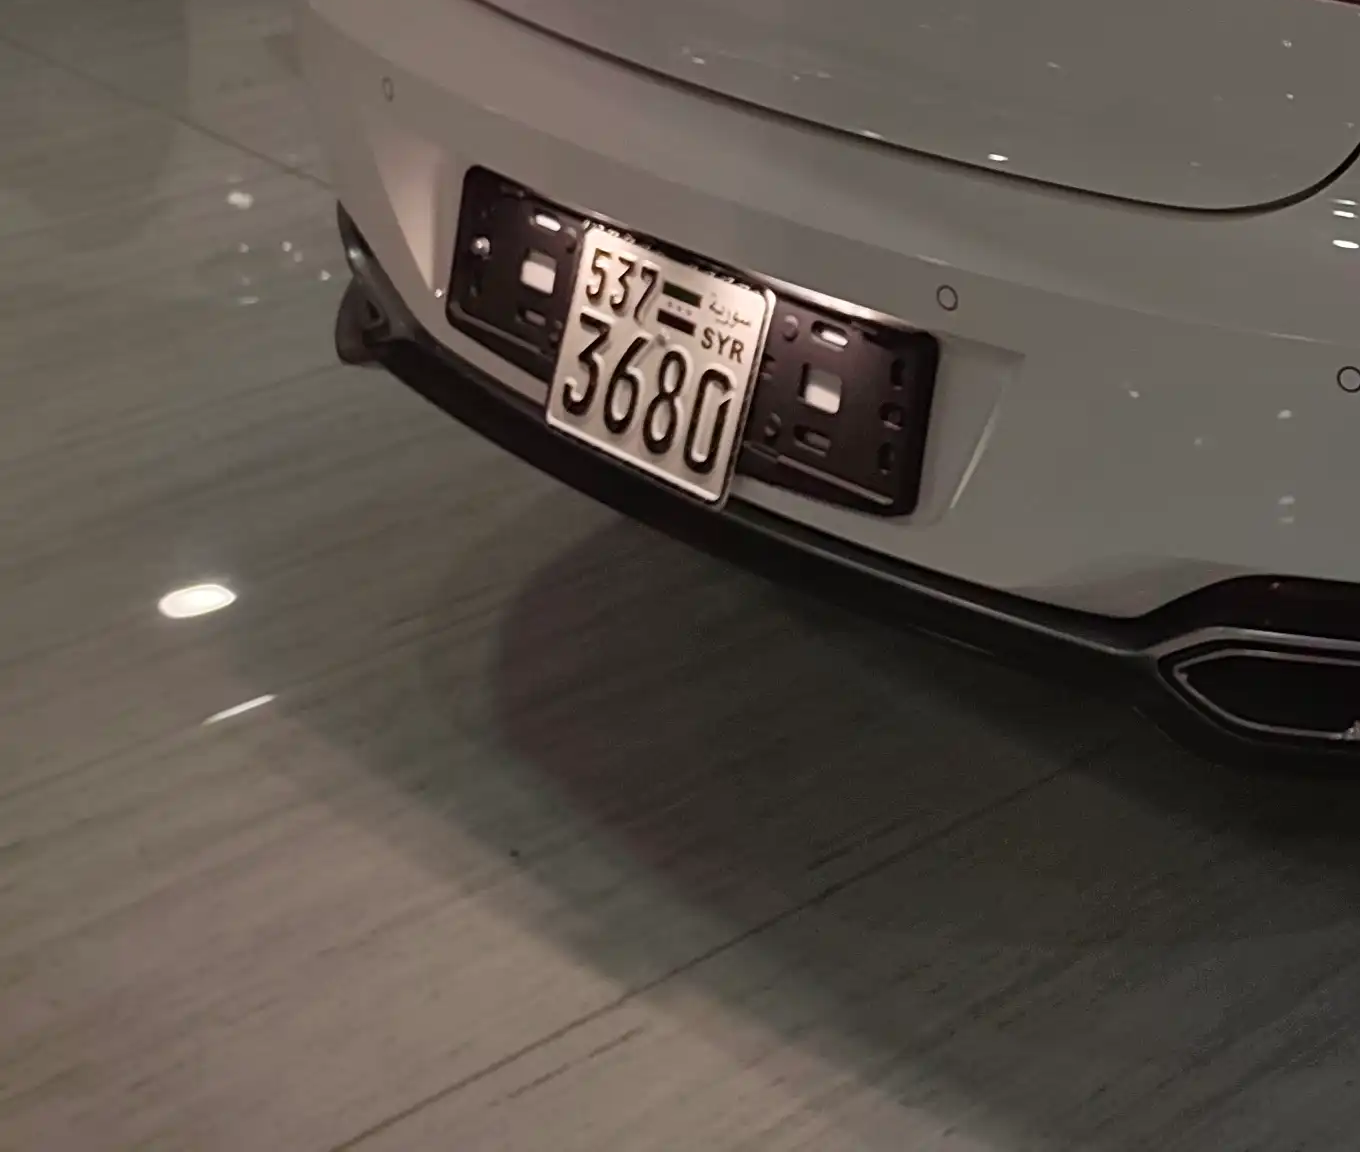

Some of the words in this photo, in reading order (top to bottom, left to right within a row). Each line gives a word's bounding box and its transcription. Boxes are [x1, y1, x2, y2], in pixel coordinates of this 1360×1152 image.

[585, 247, 659, 324] 537
[701, 327, 745, 364] SYR
[562, 312, 734, 475] 3680
